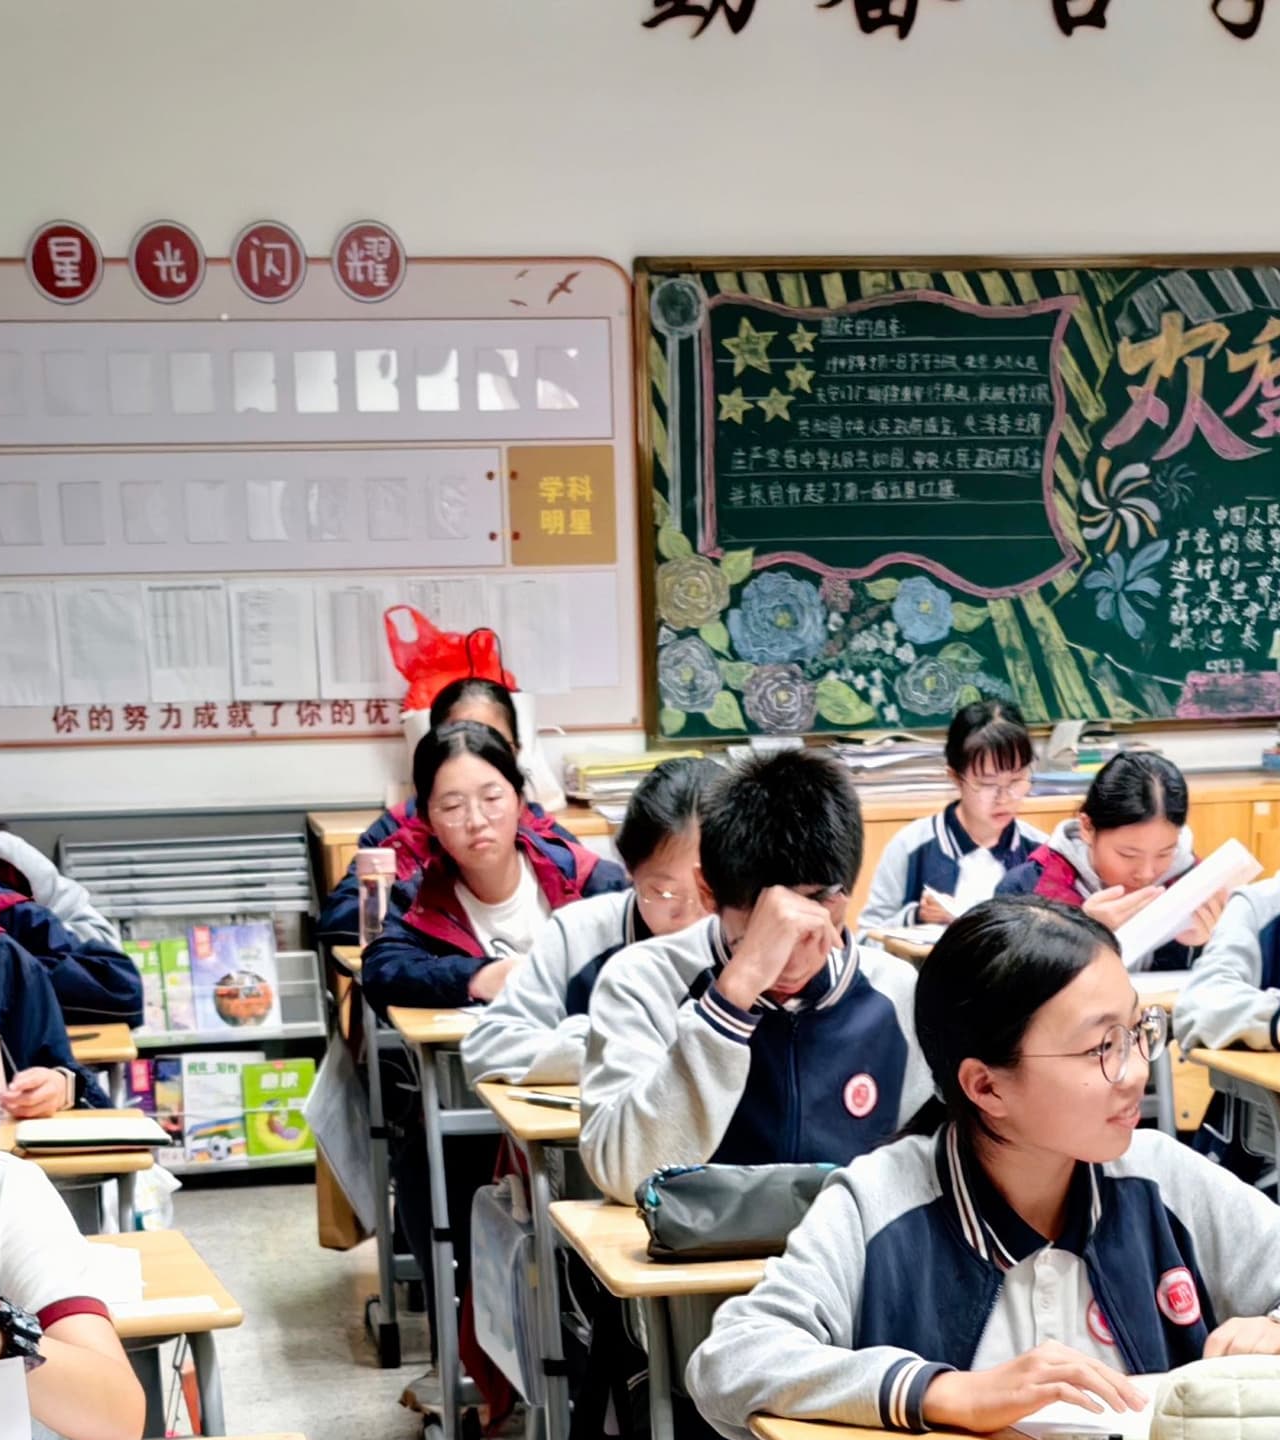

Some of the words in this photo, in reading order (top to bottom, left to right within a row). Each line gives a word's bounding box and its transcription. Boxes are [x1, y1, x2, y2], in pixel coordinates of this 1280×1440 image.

[48, 237, 391, 288] 星光闪耀
[539, 475, 592, 504] 学科
[541, 509, 592, 535] 明星
[52, 700, 406, 734] 你的努力成就了你的优
